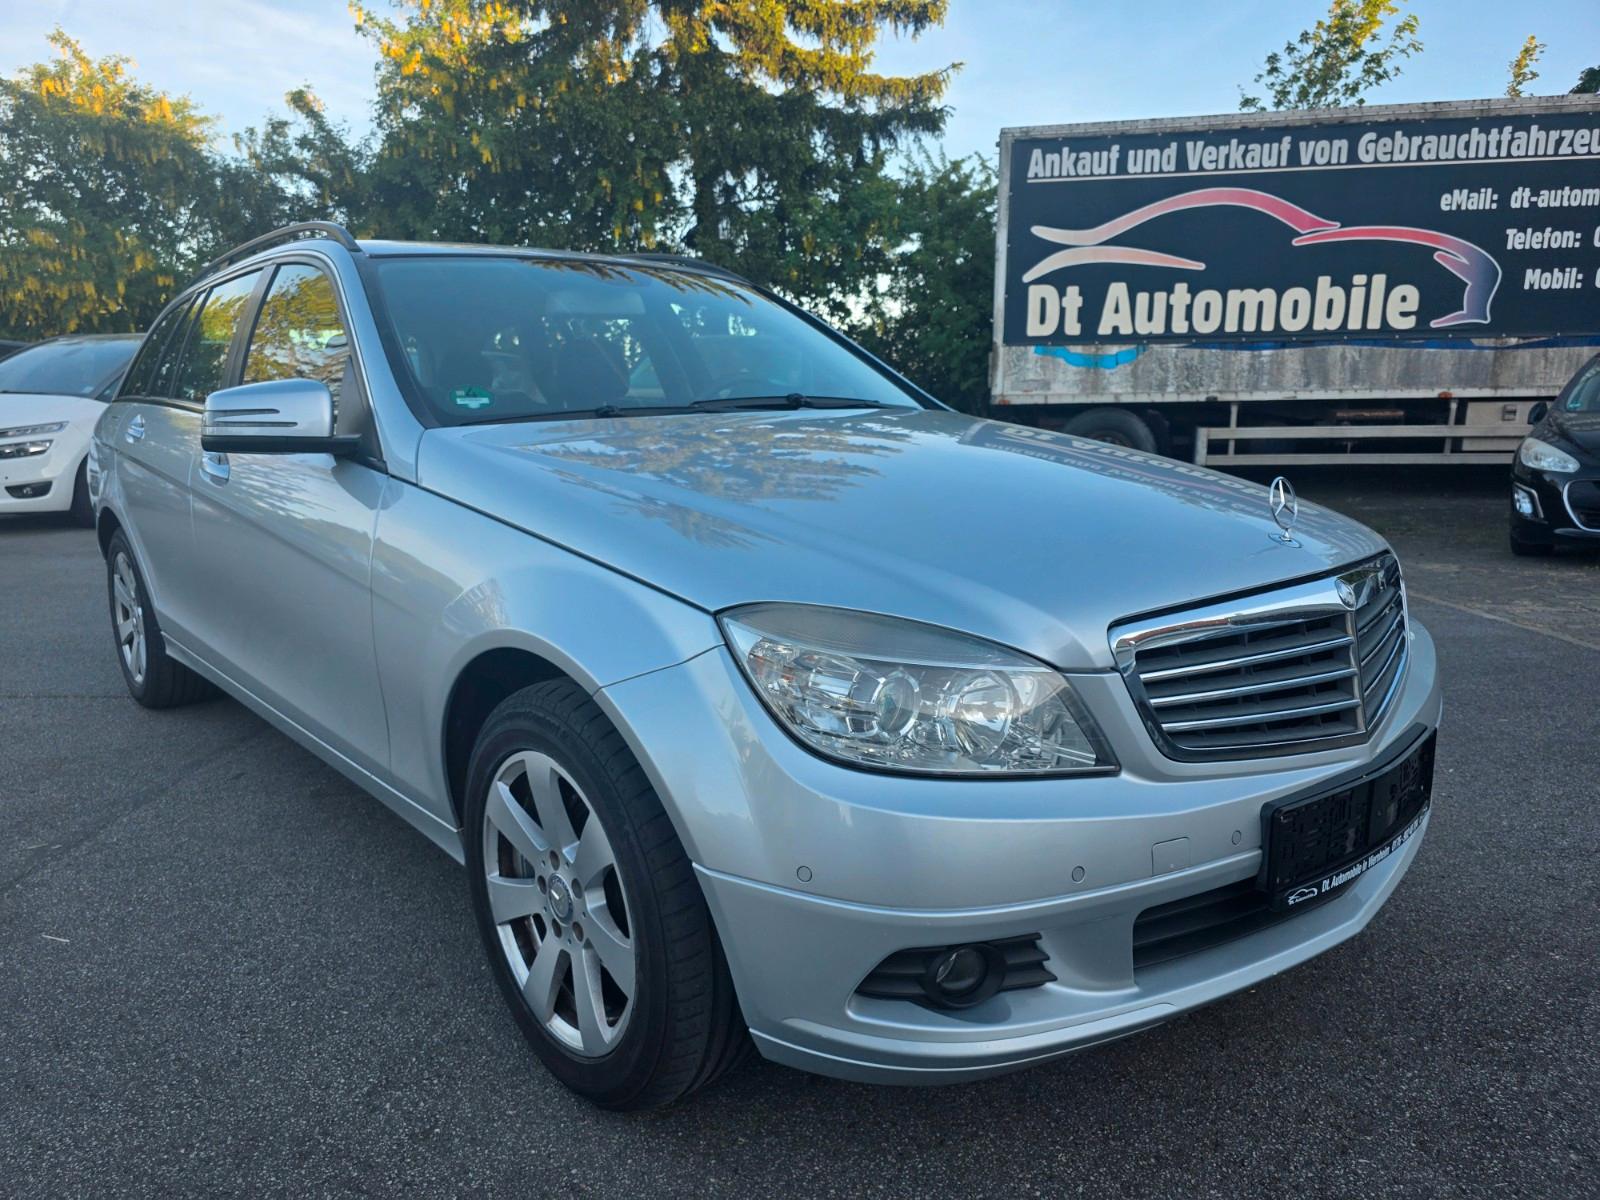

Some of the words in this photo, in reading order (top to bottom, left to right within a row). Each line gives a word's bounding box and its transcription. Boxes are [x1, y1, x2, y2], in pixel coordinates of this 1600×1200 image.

[1027, 145, 1120, 178] Ankauf
[1127, 142, 1178, 173] und
[1186, 136, 1292, 171] Verkauf
[1299, 138, 1349, 166] von
[1441, 187, 1499, 211] eMail:
[1510, 186, 1600, 209] dt-autom
[1506, 227, 1582, 250] Telefon:
[1524, 267, 1584, 290] Mobil:
[1026, 284, 1083, 336] Dt
[1097, 274, 1420, 335] Automobile
